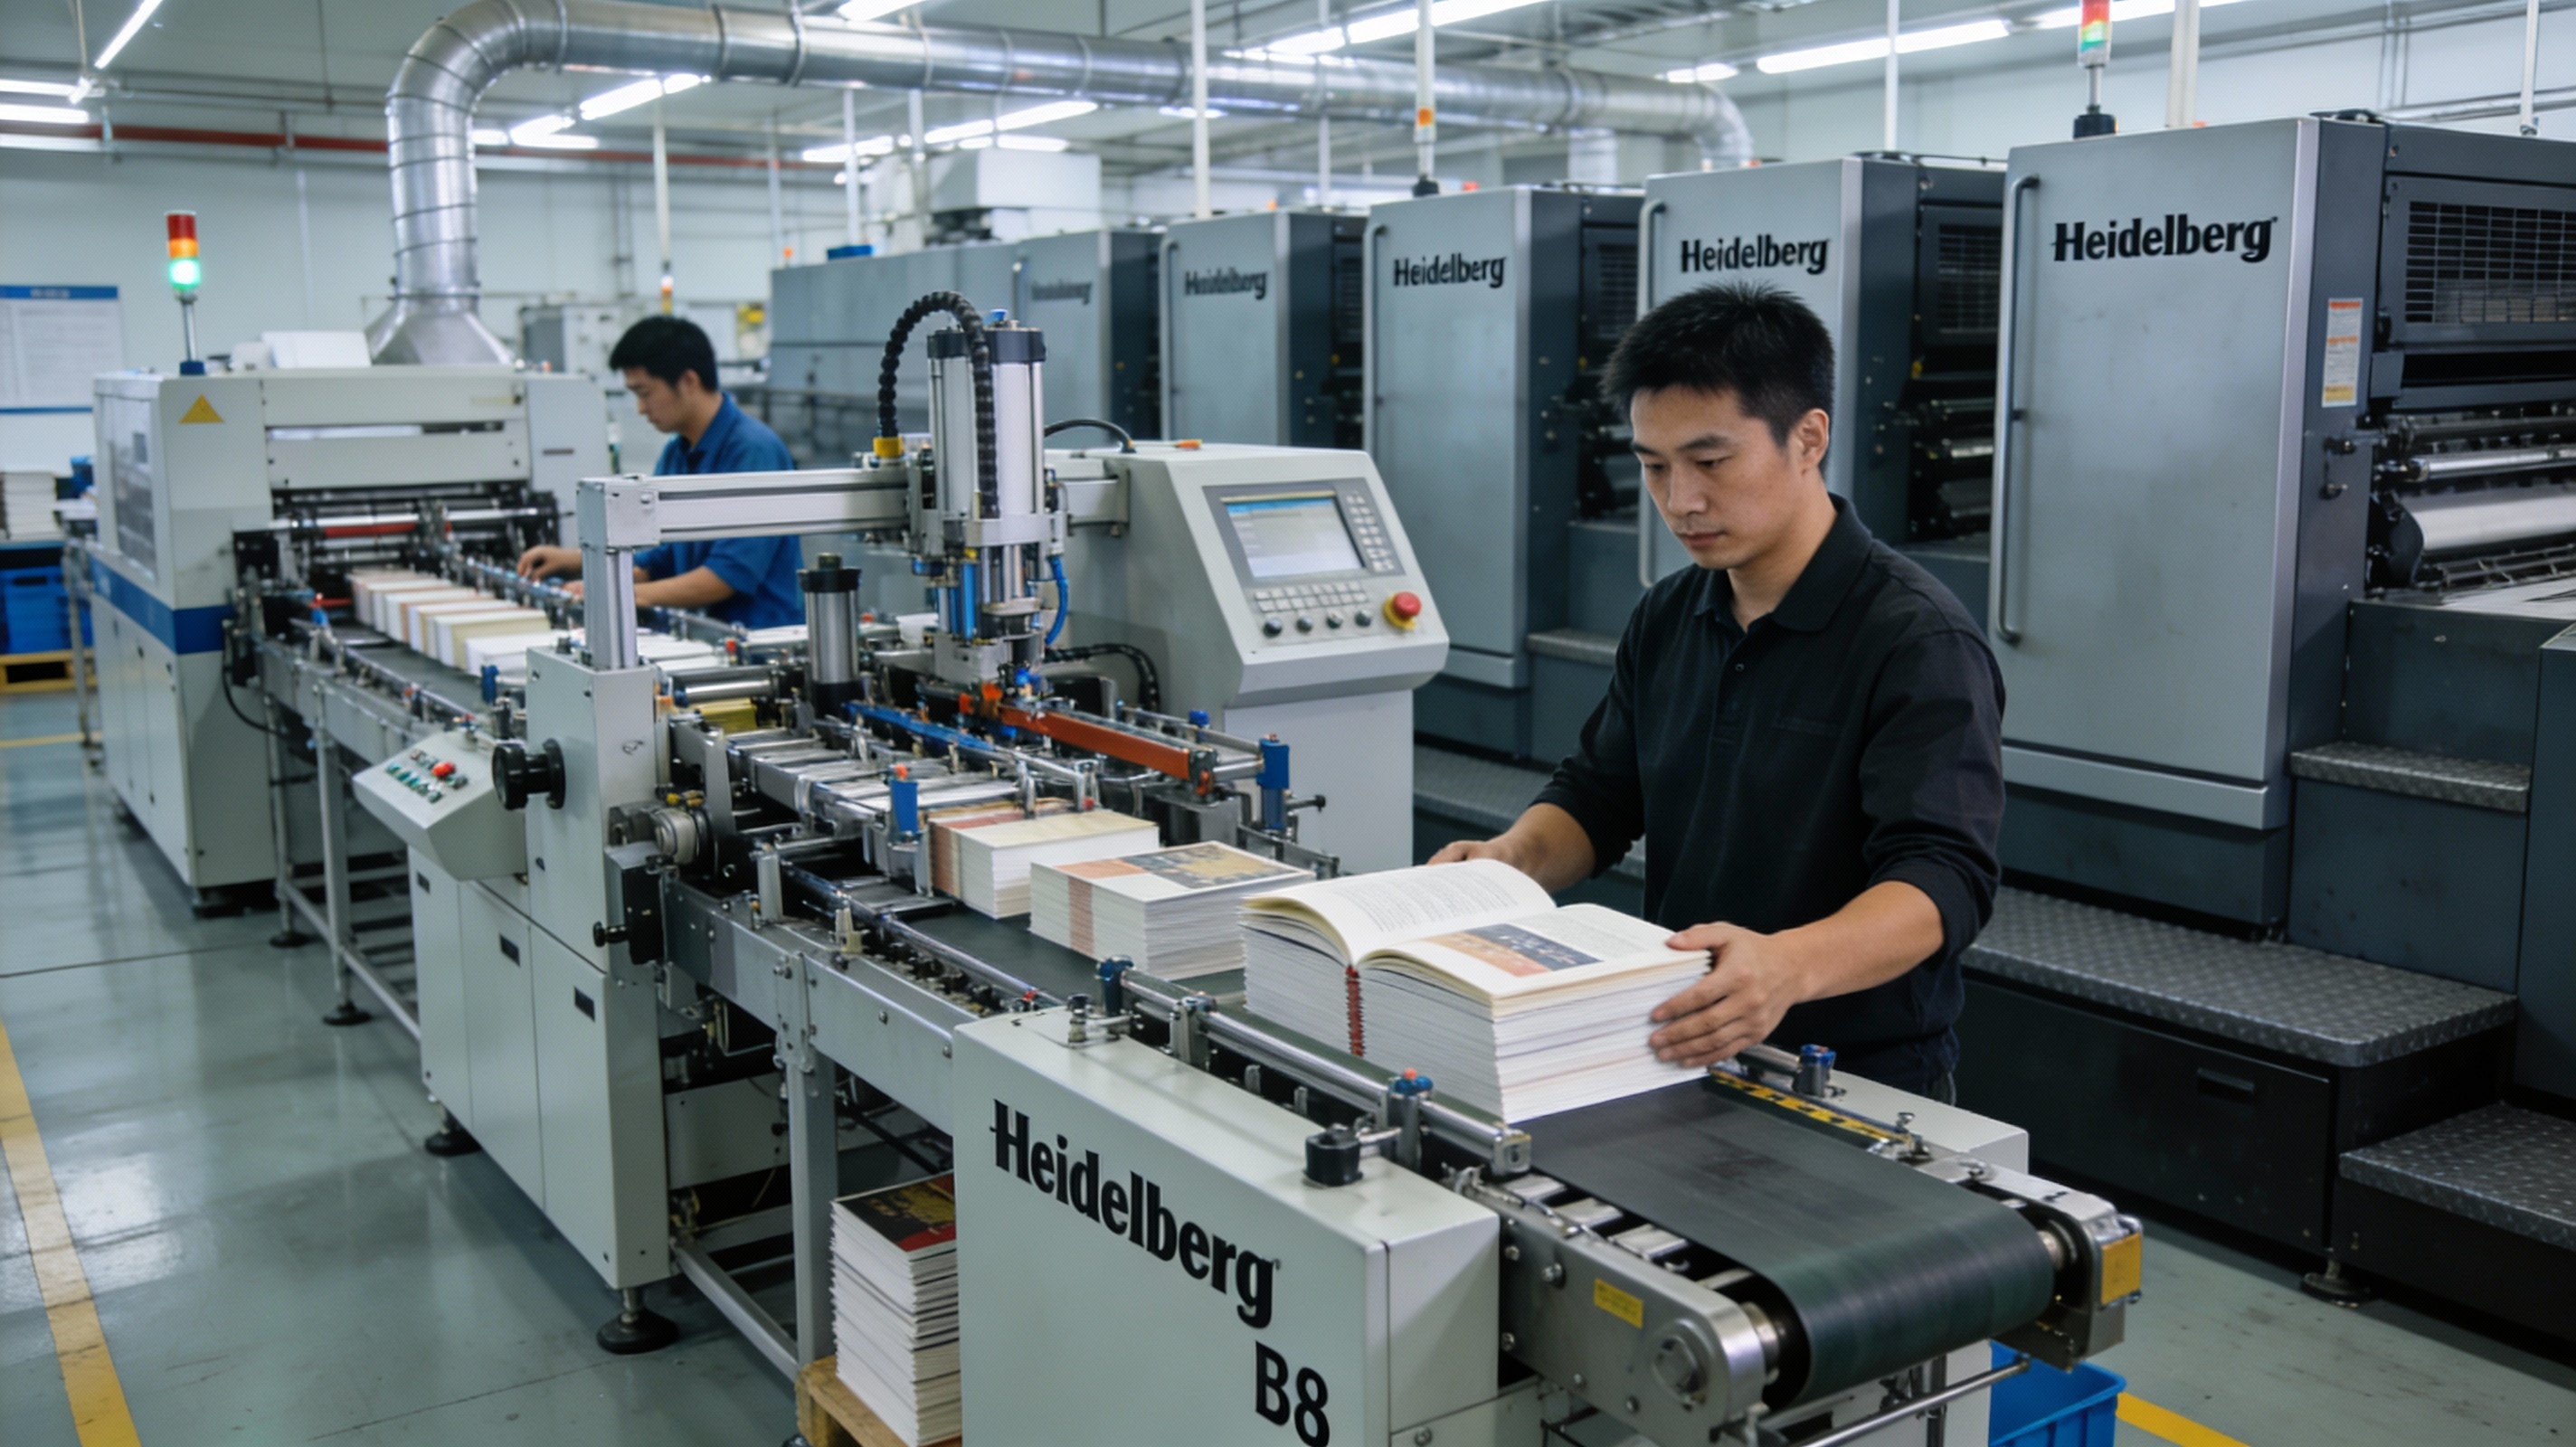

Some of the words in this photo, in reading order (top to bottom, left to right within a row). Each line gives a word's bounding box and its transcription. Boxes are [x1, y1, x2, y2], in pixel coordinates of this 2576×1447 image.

[1681, 234, 1829, 275] Heidelberg
[2051, 213, 2278, 263] Heidelberg
[1394, 253, 1505, 288] Heidelberg
[990, 1099, 1280, 1329] Heidelberg
[1255, 1340, 1330, 1447] B8
